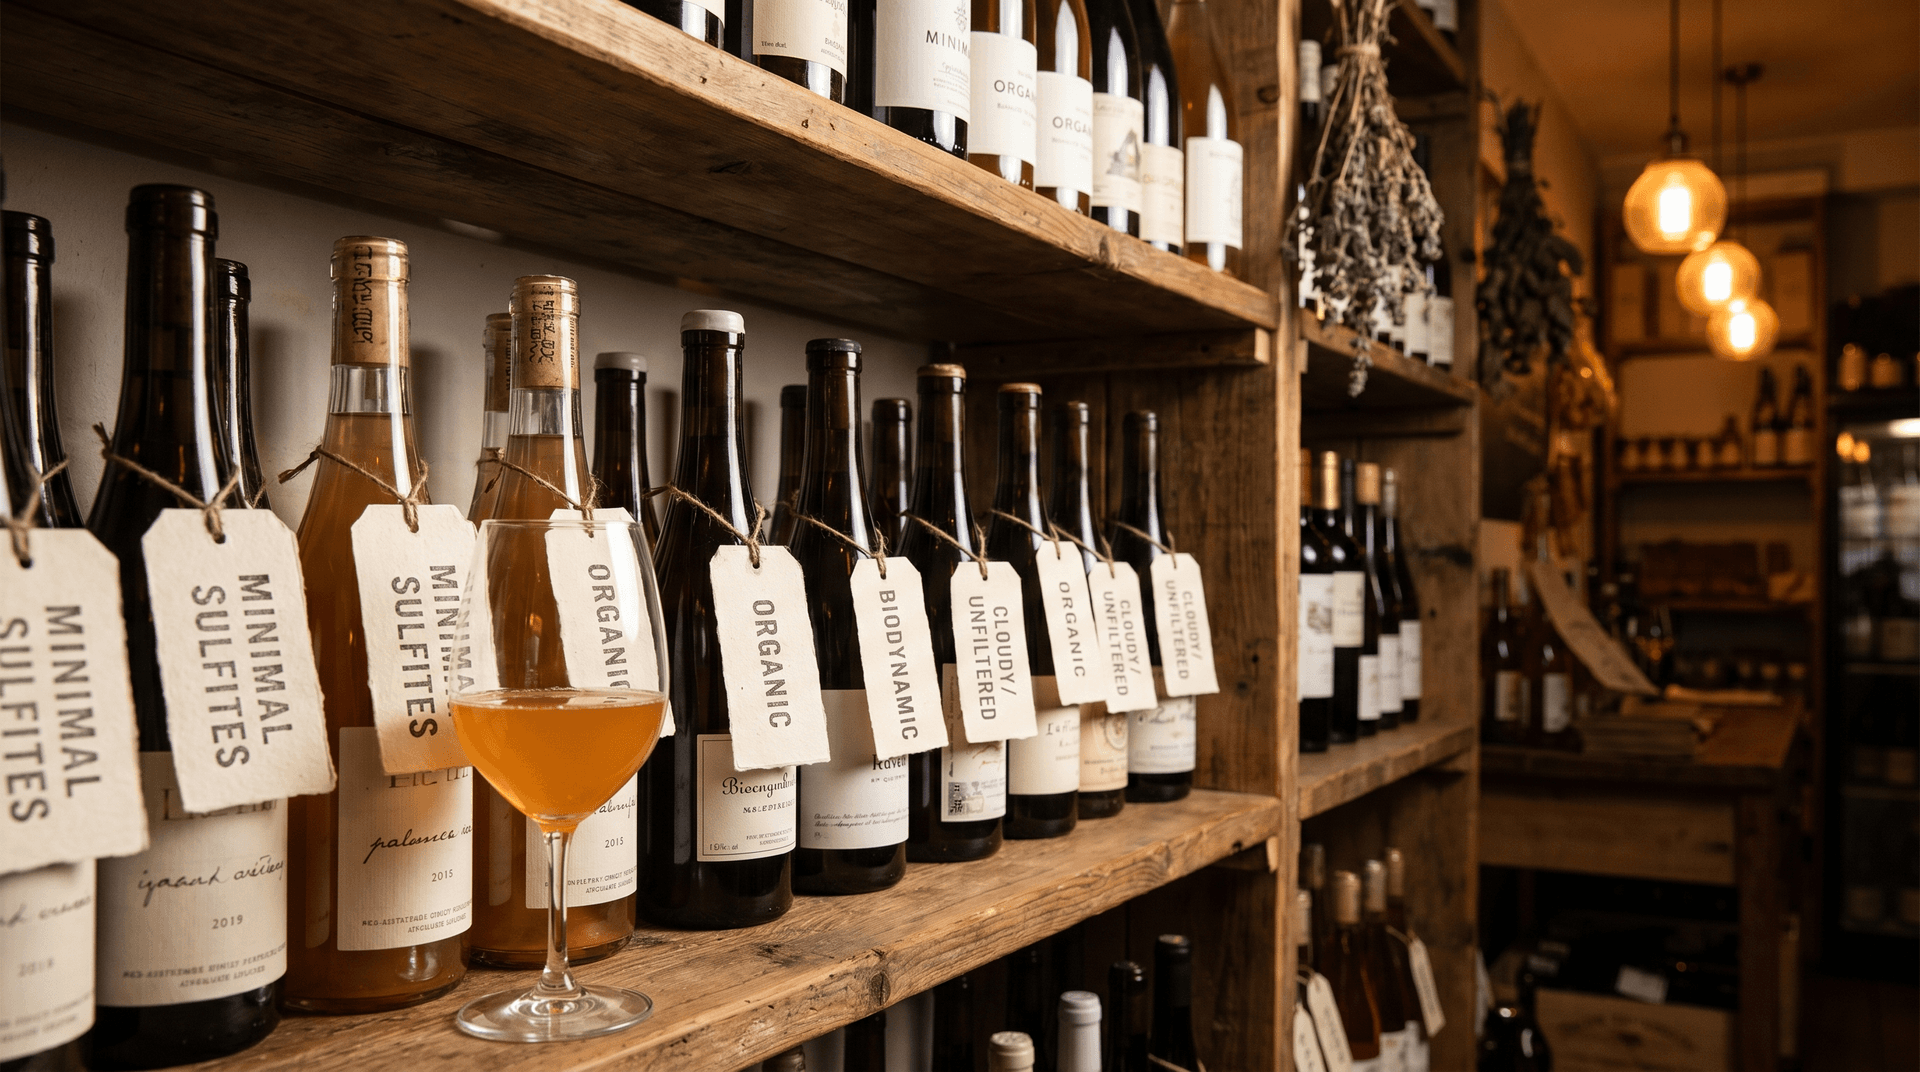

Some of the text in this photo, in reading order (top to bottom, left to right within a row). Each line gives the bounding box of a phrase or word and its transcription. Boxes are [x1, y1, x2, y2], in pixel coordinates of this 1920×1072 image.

[191, 585, 250, 768] SULFITES
[238, 574, 293, 744] MINIMAL
[391, 576, 438, 738] SULFITES
[752, 599, 792, 728] ORGANIC
[879, 589, 919, 740] BIODYNAMIC
[968, 596, 997, 721] UNFILTERED
[993, 606, 1017, 696] CLOUDY/
[1058, 581, 1086, 678] ORGANIC
[1103, 591, 1129, 696] UNFILTERED
[1119, 600, 1141, 675] CLOUDY/
[1165, 580, 1190, 680] UNFILTERED
[1182, 591, 1201, 660] CLOUDY/
[0, 618, 49, 823] SULFITES
[45, 605, 101, 797] MINIMAL
[431, 869, 454, 882] 2015
[605, 837, 624, 848] 2015
[211, 914, 244, 930] 2019
